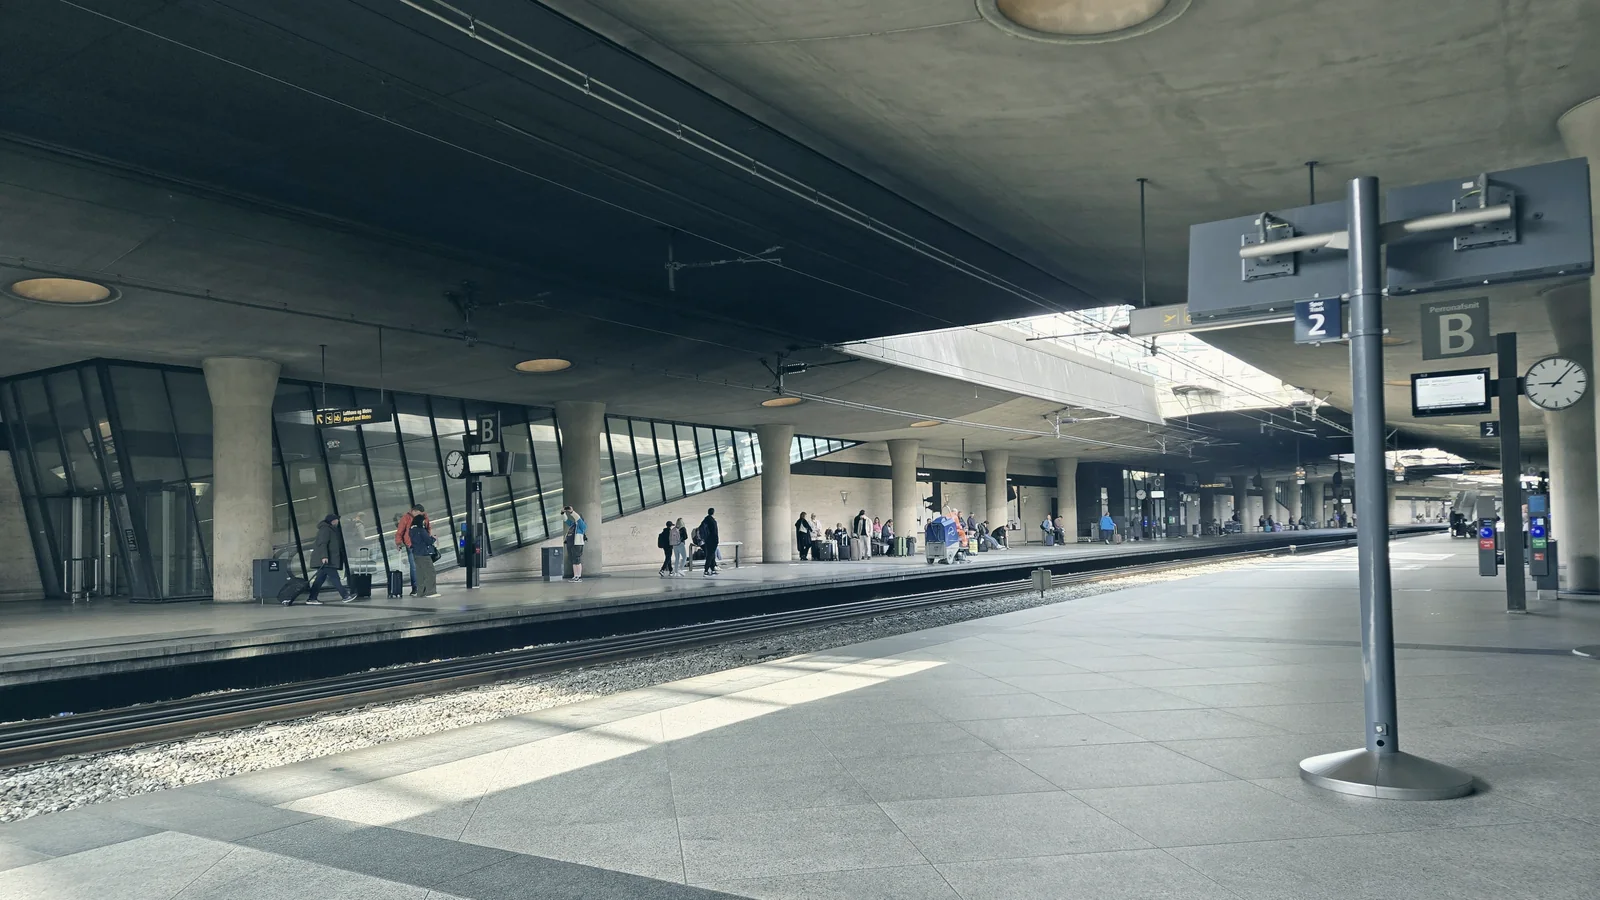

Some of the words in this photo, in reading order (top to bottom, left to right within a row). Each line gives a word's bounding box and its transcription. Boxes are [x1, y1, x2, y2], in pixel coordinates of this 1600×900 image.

[1429, 301, 1480, 313] Perronafsnit
[1308, 313, 1326, 335] 2
[1439, 313, 1474, 355] B
[482, 418, 494, 442] B
[1486, 427, 1495, 436] 2
[1154, 478, 1161, 487] C
